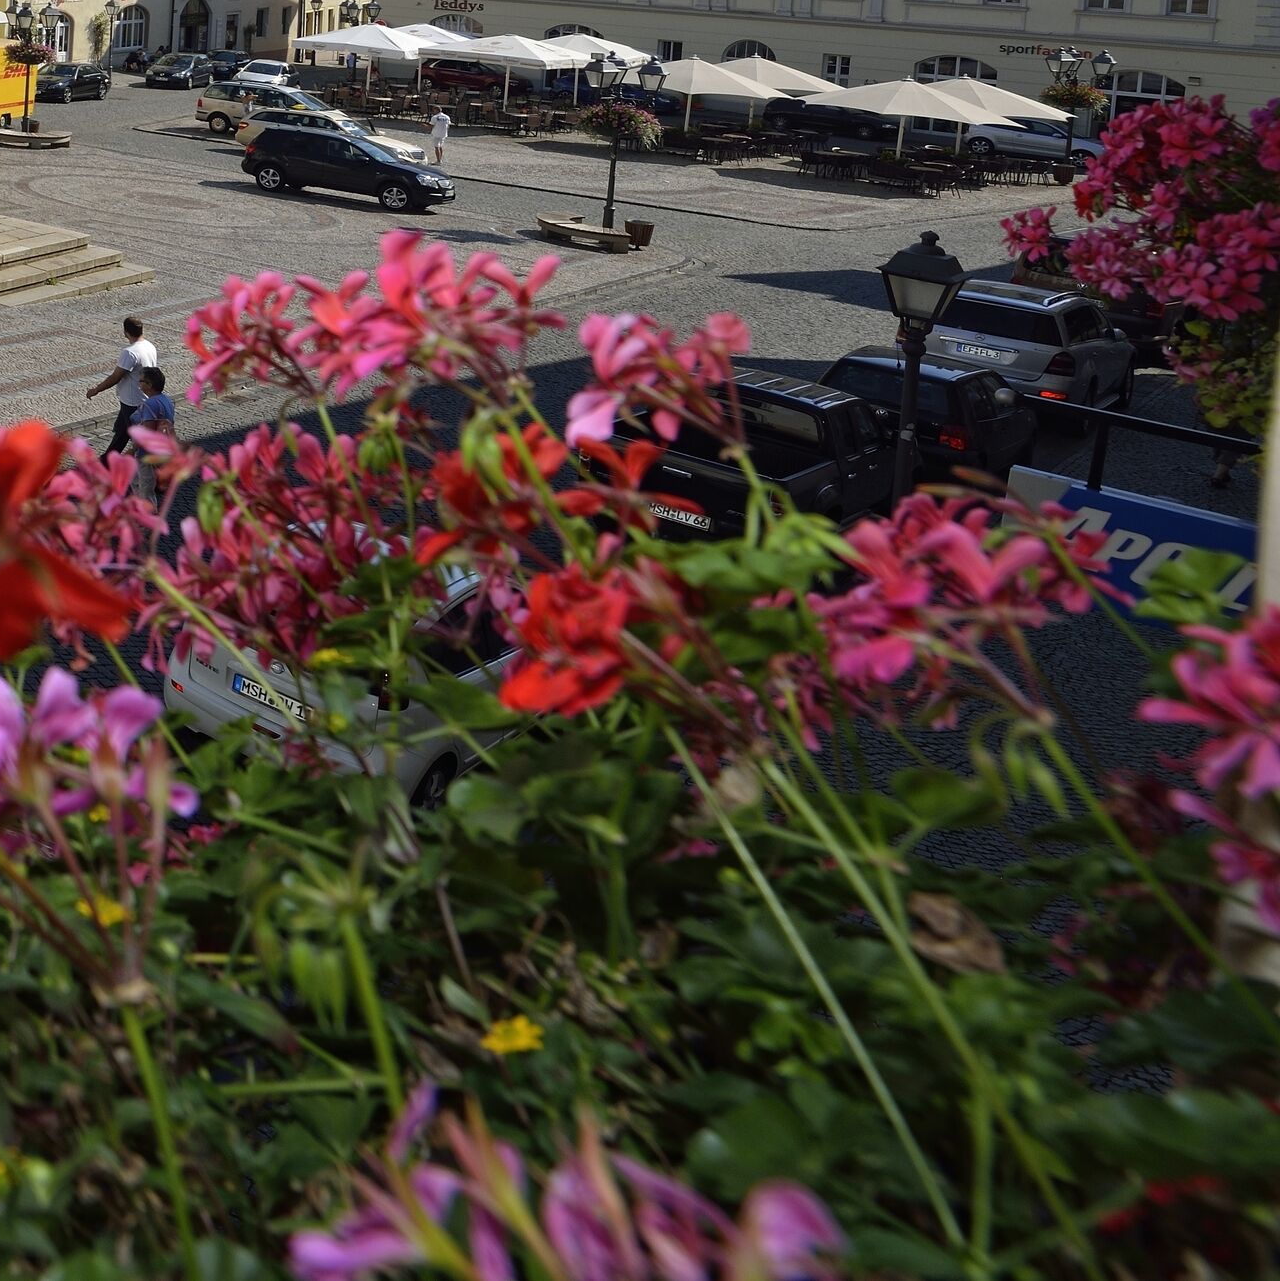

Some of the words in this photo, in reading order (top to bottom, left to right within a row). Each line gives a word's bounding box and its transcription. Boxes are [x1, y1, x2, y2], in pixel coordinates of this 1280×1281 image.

[649, 503, 671, 517] MSH
[676, 510, 692, 522] LV
[693, 516, 707, 527] 66
[241, 679, 268, 702] MSH
